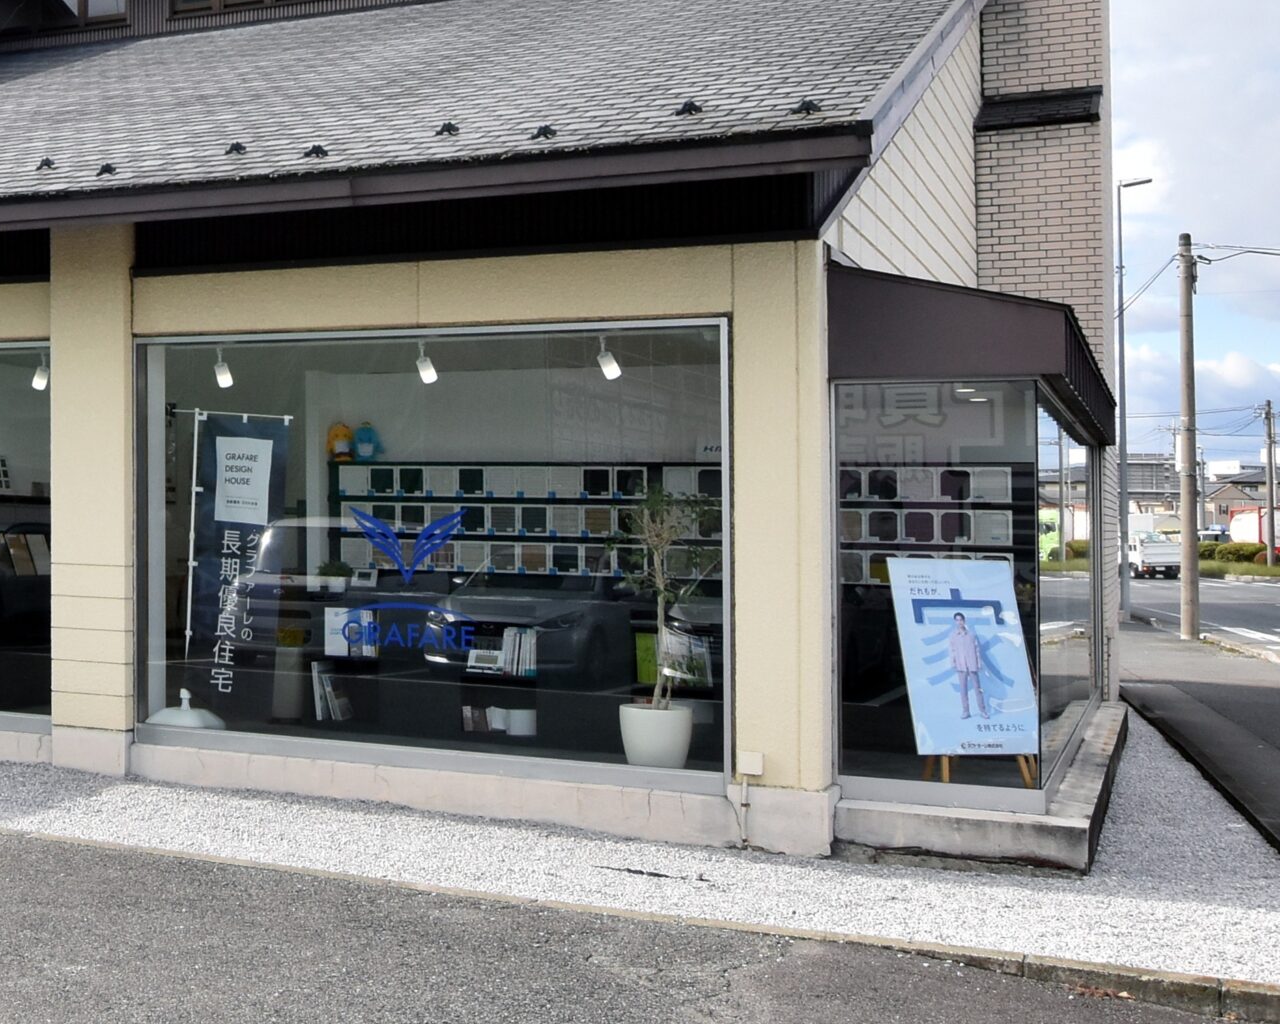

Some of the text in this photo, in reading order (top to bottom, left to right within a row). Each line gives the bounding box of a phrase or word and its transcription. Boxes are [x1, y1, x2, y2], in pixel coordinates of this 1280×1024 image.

[225, 452, 259, 463] GRAFARE
[224, 464, 253, 474] DESIGN
[224, 476, 251, 486] HOUSE
[240, 529, 261, 641] グラファーレの
[209, 530, 241, 693] 長期優良住宅
[342, 619, 476, 652] GRAFARE
